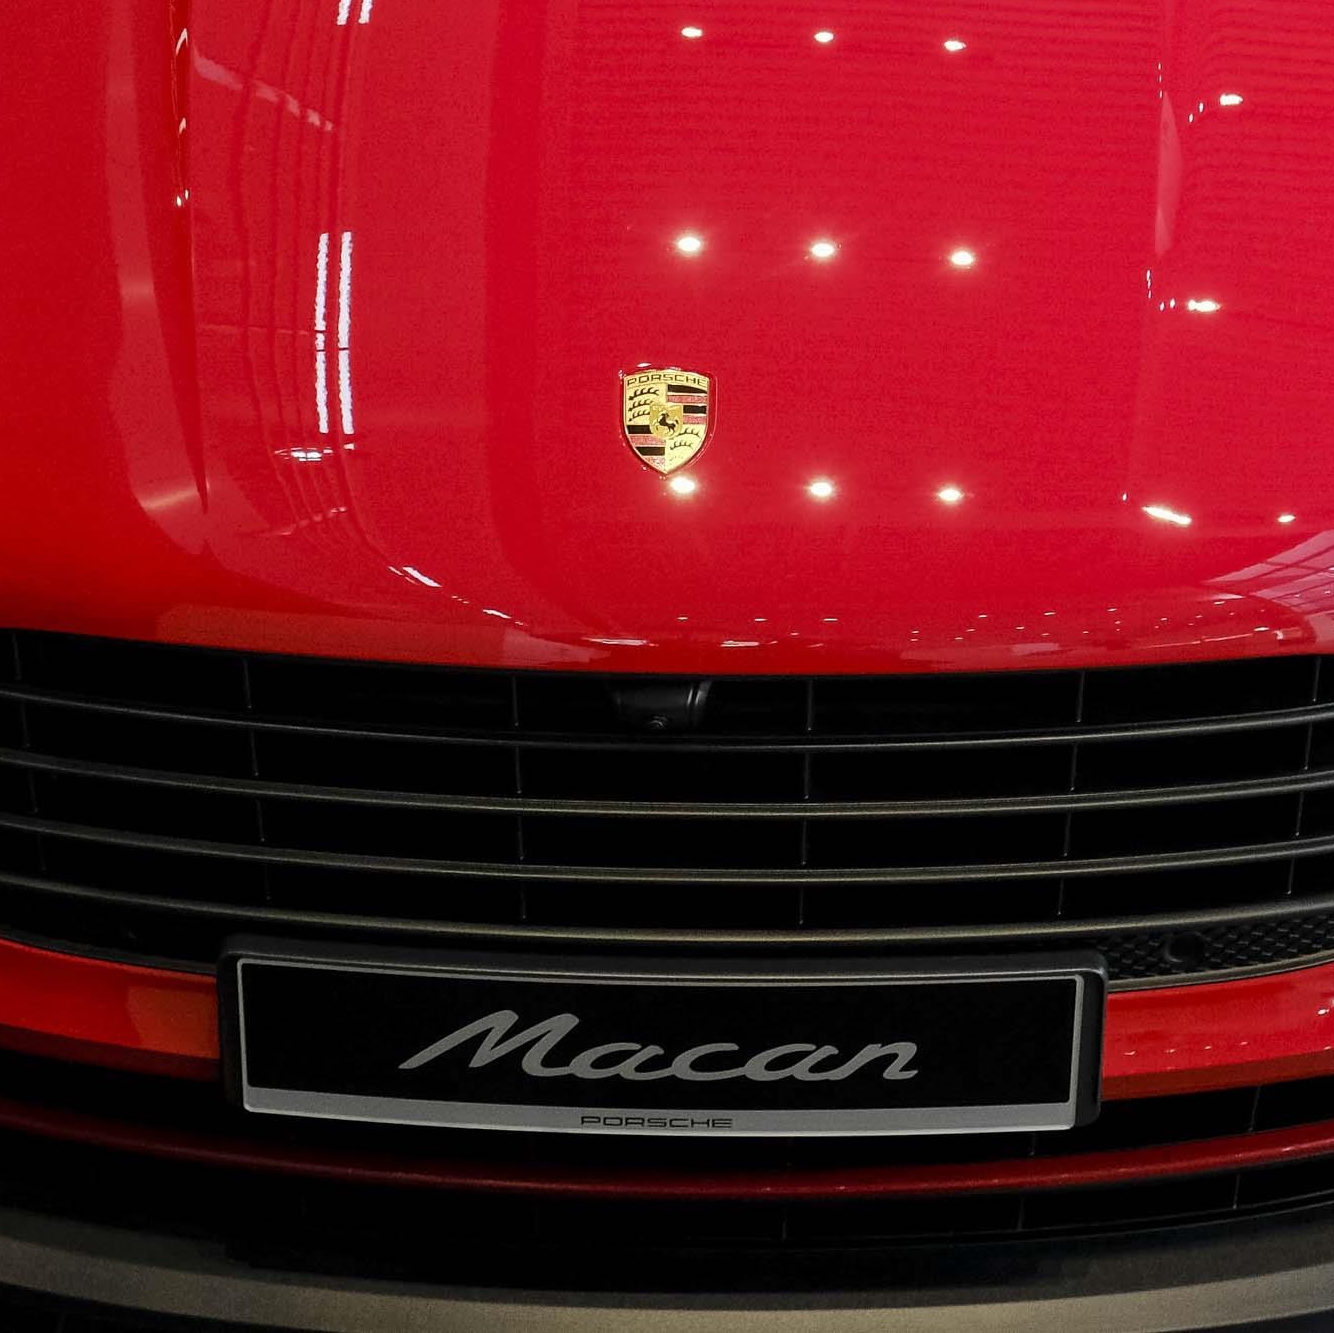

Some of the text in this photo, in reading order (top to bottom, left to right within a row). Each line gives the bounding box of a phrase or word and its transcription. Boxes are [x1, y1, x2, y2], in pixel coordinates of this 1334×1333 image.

[627, 373, 708, 387] PORSCHE
[398, 1010, 919, 1081] Macan
[581, 1116, 733, 1129] PORSCHE
